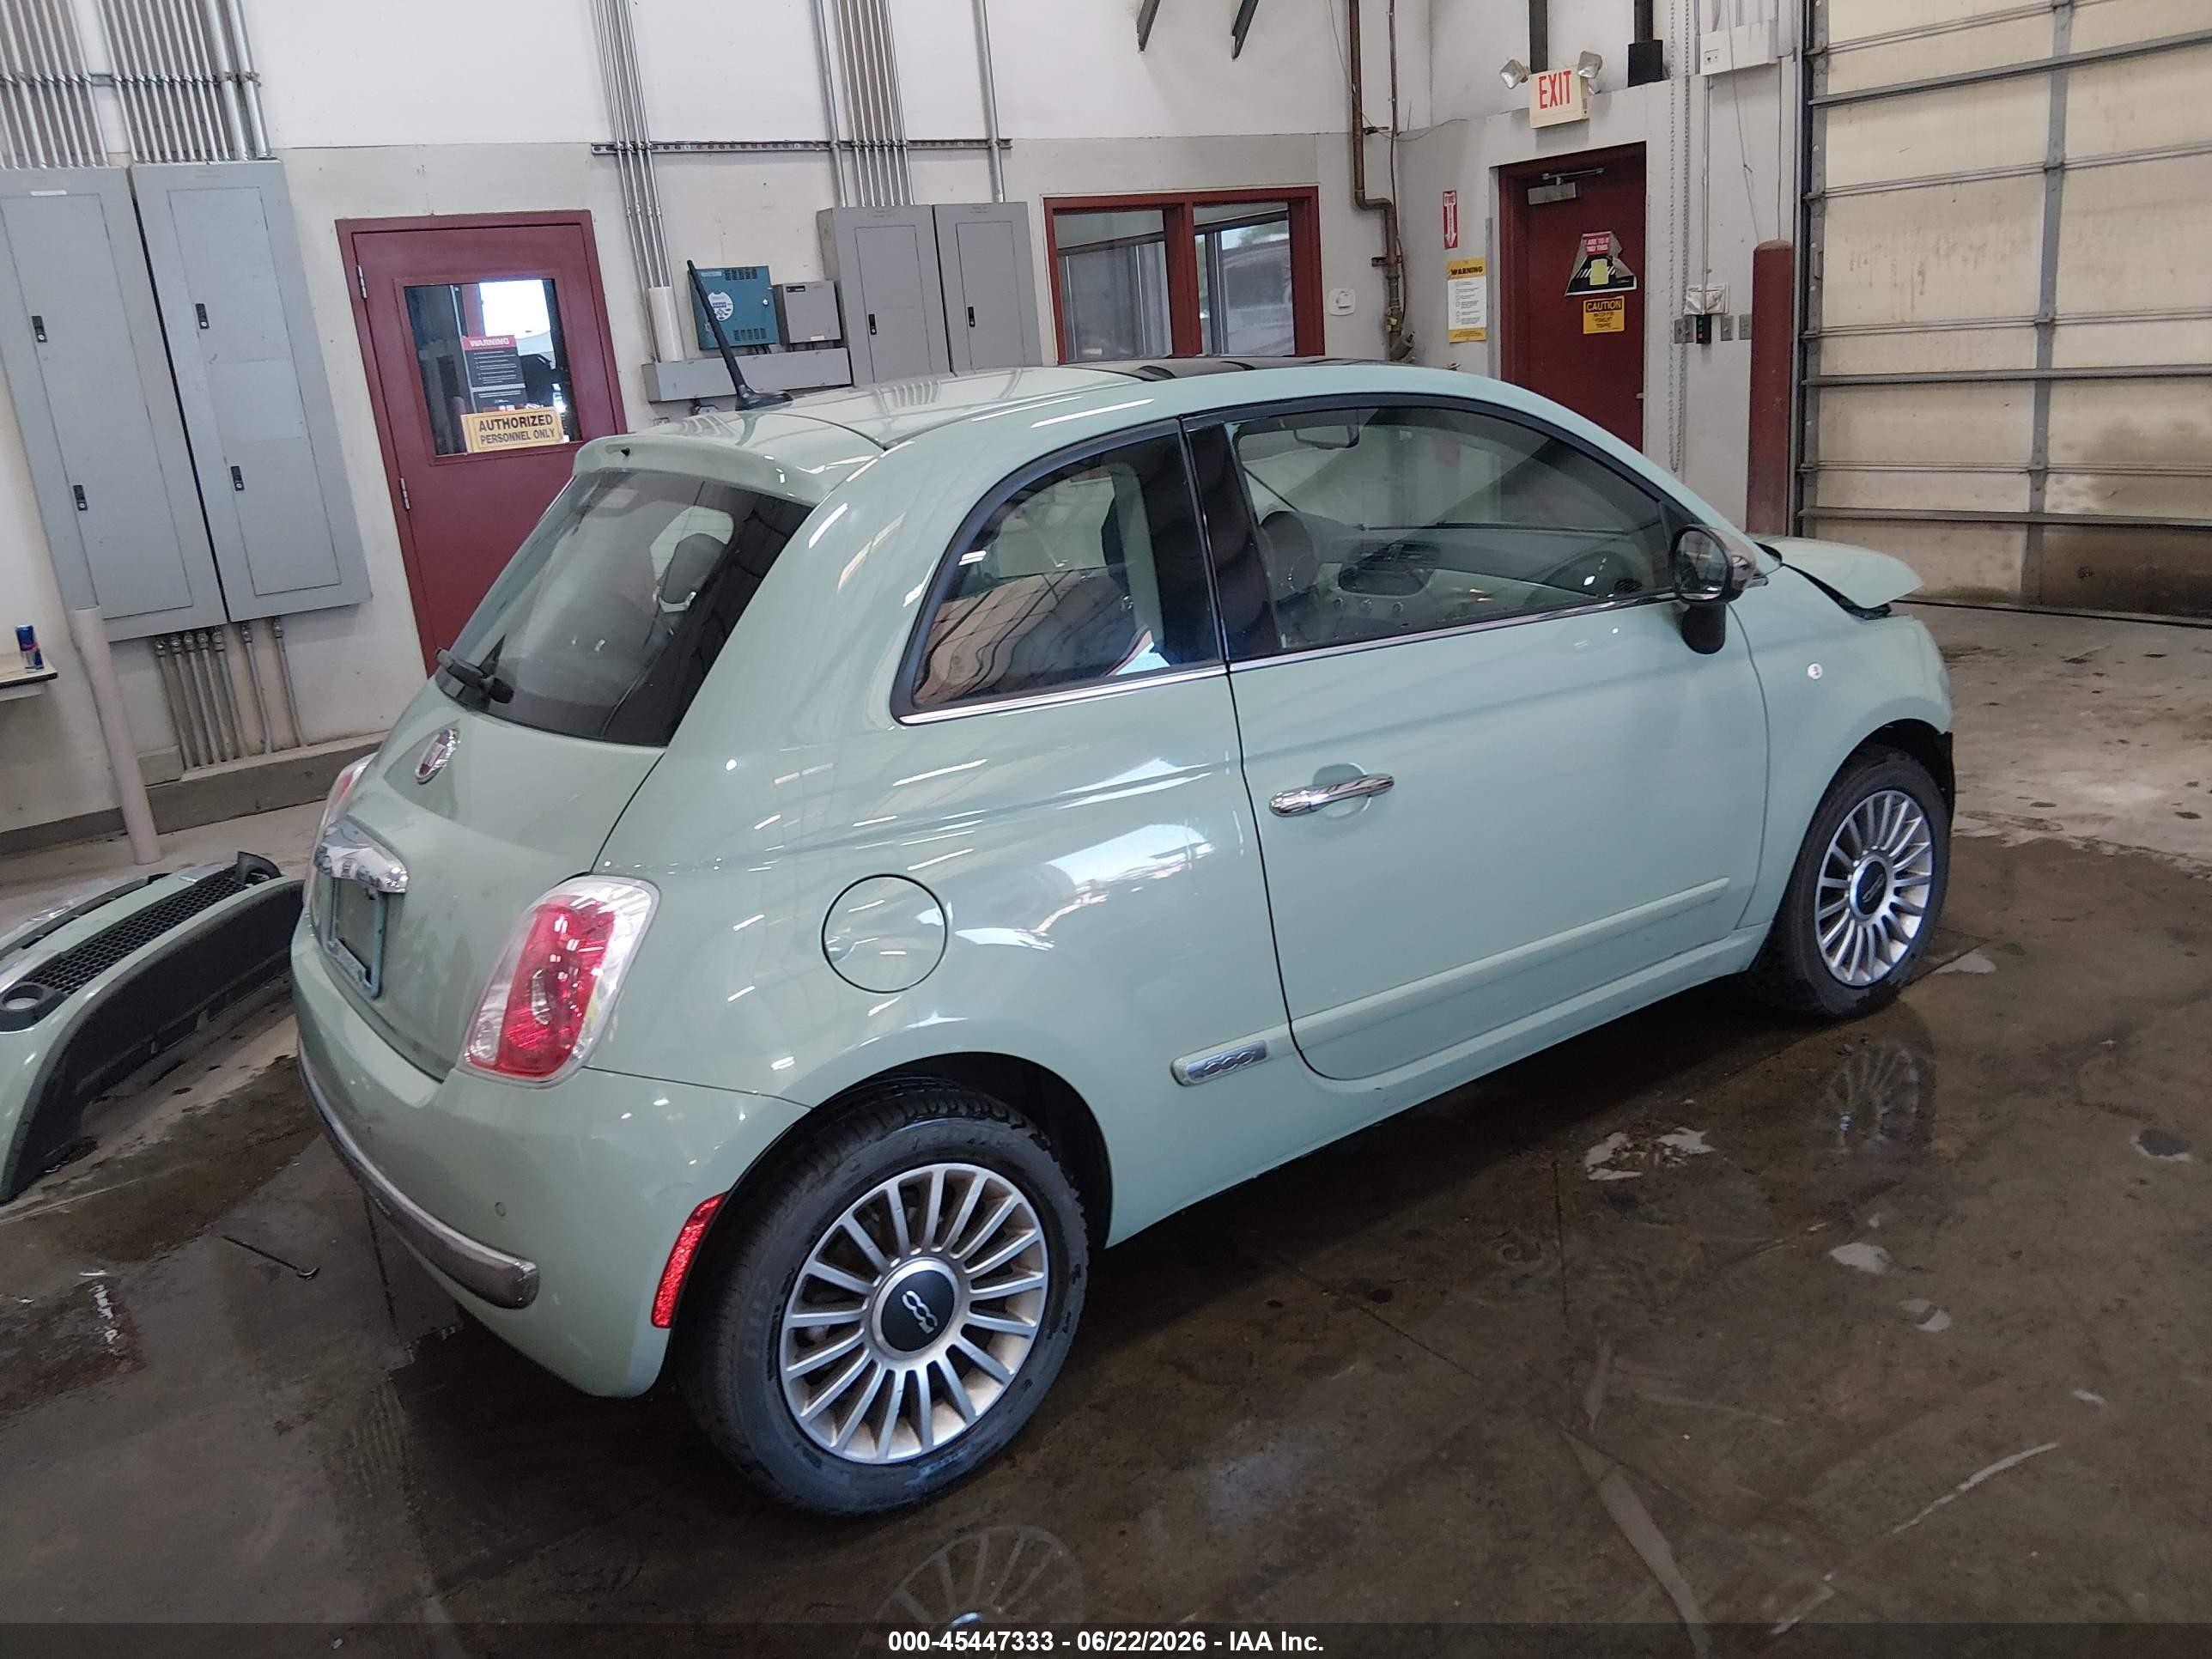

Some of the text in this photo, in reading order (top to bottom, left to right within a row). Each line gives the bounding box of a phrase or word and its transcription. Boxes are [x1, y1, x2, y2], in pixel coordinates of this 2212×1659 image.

[1538, 70, 1571, 109] EXIT
[1450, 265, 1483, 276] WARNING
[1586, 300, 1622, 311] CAUTION
[469, 337, 510, 347] WARNING
[478, 414, 554, 432] AUTHORIZED
[480, 428, 556, 445] PERSONNEL ONLY
